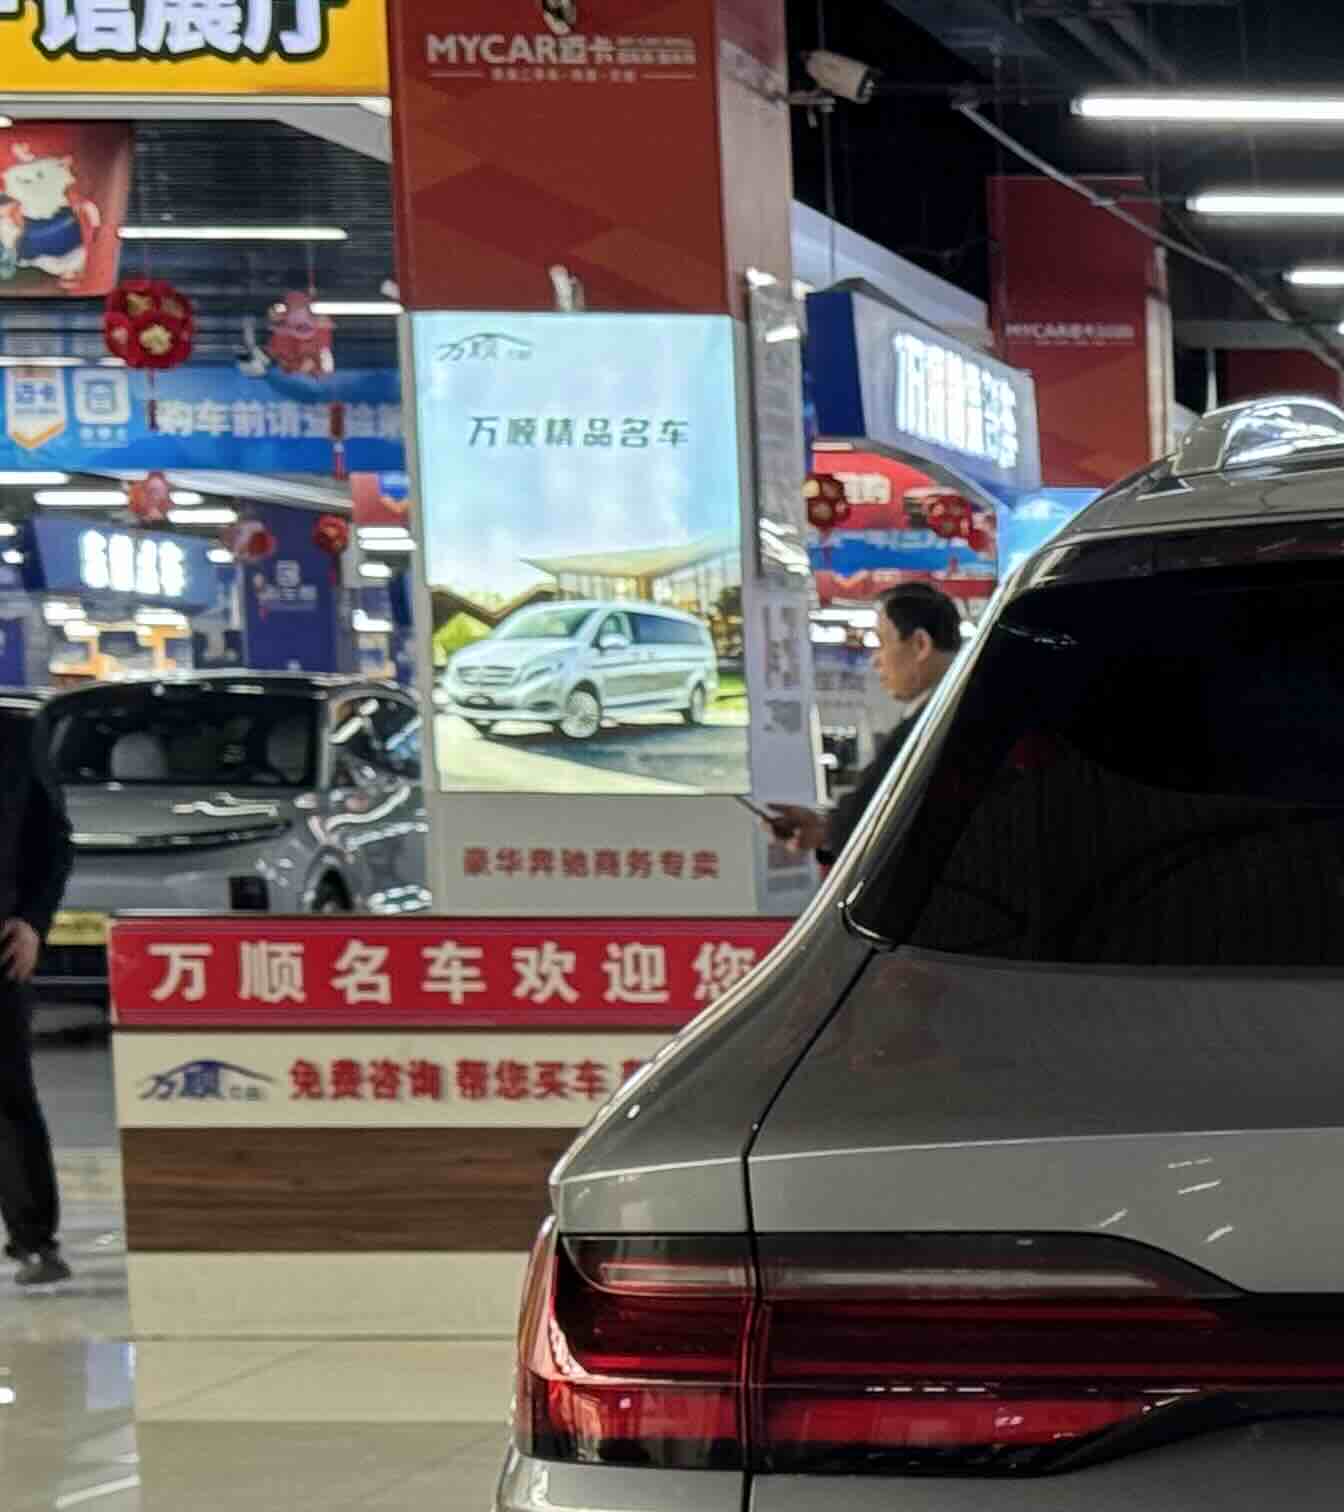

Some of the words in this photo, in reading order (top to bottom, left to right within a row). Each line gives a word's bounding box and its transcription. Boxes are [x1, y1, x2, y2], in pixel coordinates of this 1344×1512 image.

[468, 415, 689, 448] 万顺精品名车
[147, 939, 757, 1005] 万顺名车欢迎您
